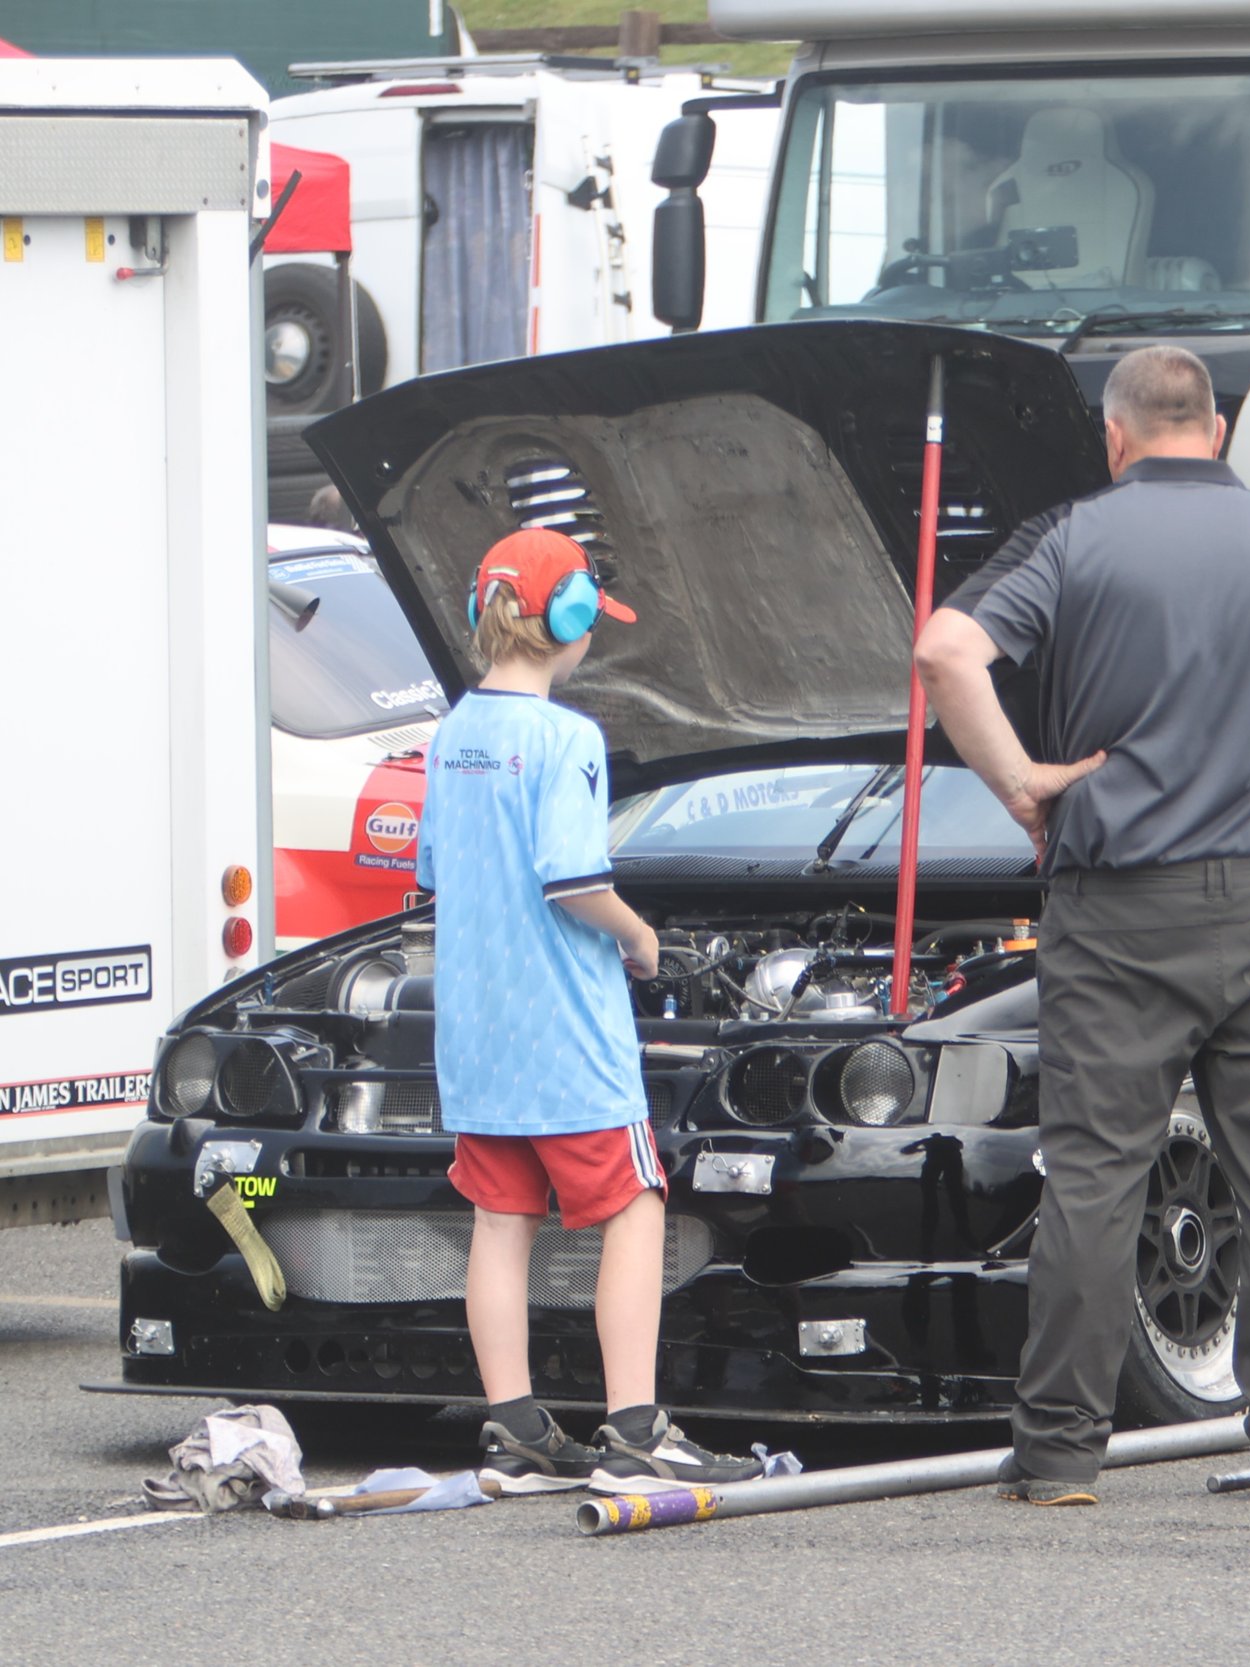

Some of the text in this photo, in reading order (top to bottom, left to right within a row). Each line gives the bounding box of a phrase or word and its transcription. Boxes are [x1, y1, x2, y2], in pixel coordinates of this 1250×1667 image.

[459, 749, 490, 758] TOTAL
[444, 760, 501, 770] MACHINING
[717, 793, 729, 815] D
[368, 817, 416, 837] Gulf
[359, 854, 415, 870] Racing Fuels
[61, 963, 144, 993] SPORT
[12, 1081, 72, 1114] JAMES
[233, 1176, 277, 1197] TOW
